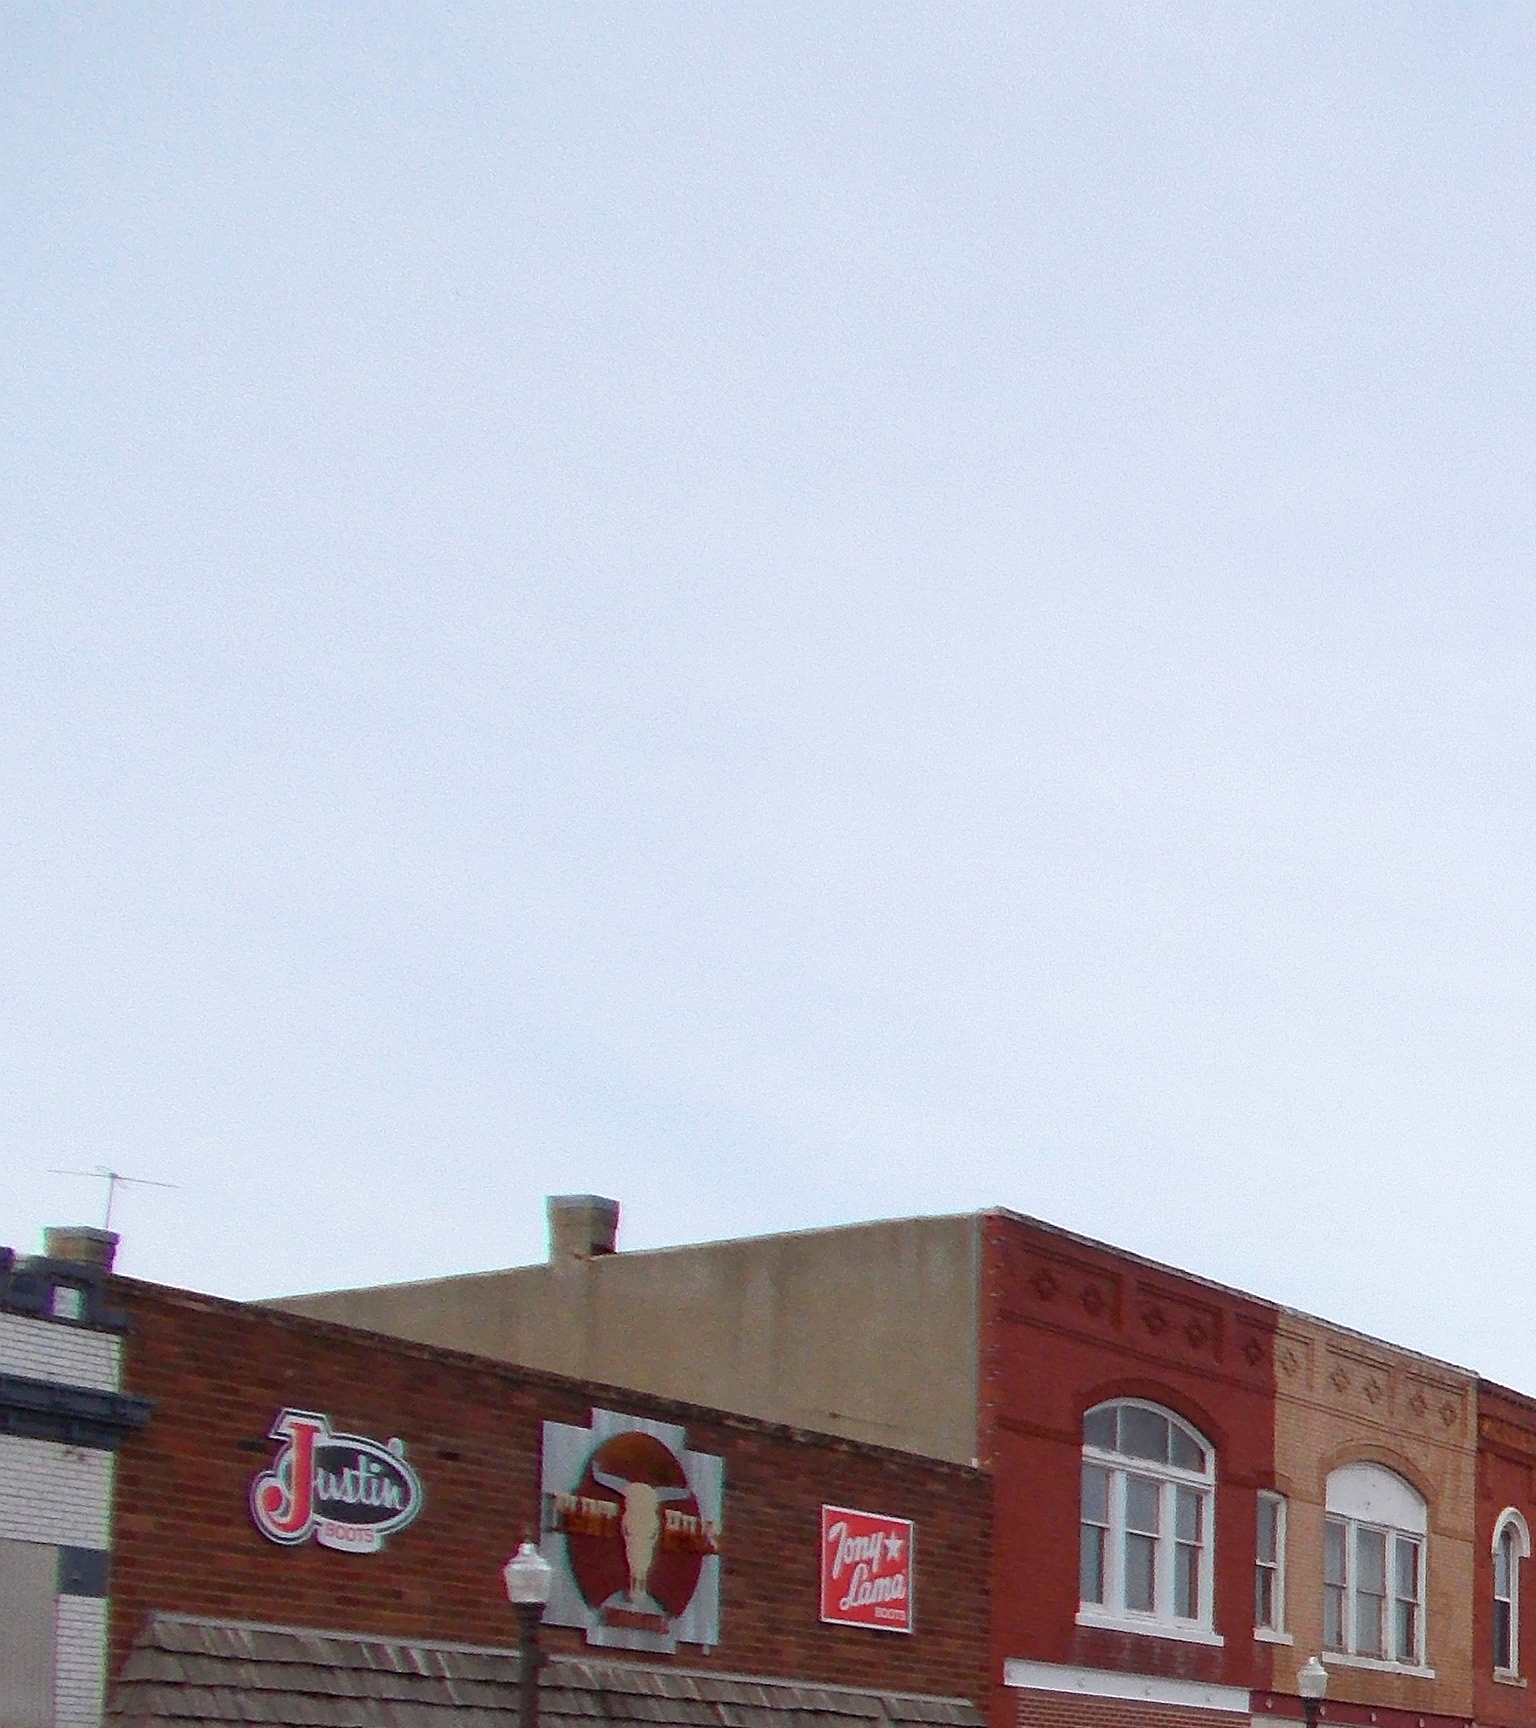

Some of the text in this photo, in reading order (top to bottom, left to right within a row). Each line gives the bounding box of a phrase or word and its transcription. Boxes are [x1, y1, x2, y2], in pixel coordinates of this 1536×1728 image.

[257, 1419, 405, 1536] Justin
[324, 1524, 375, 1544] BOOTS
[828, 1521, 885, 1579] Tony
[840, 1563, 907, 1611] Lama
